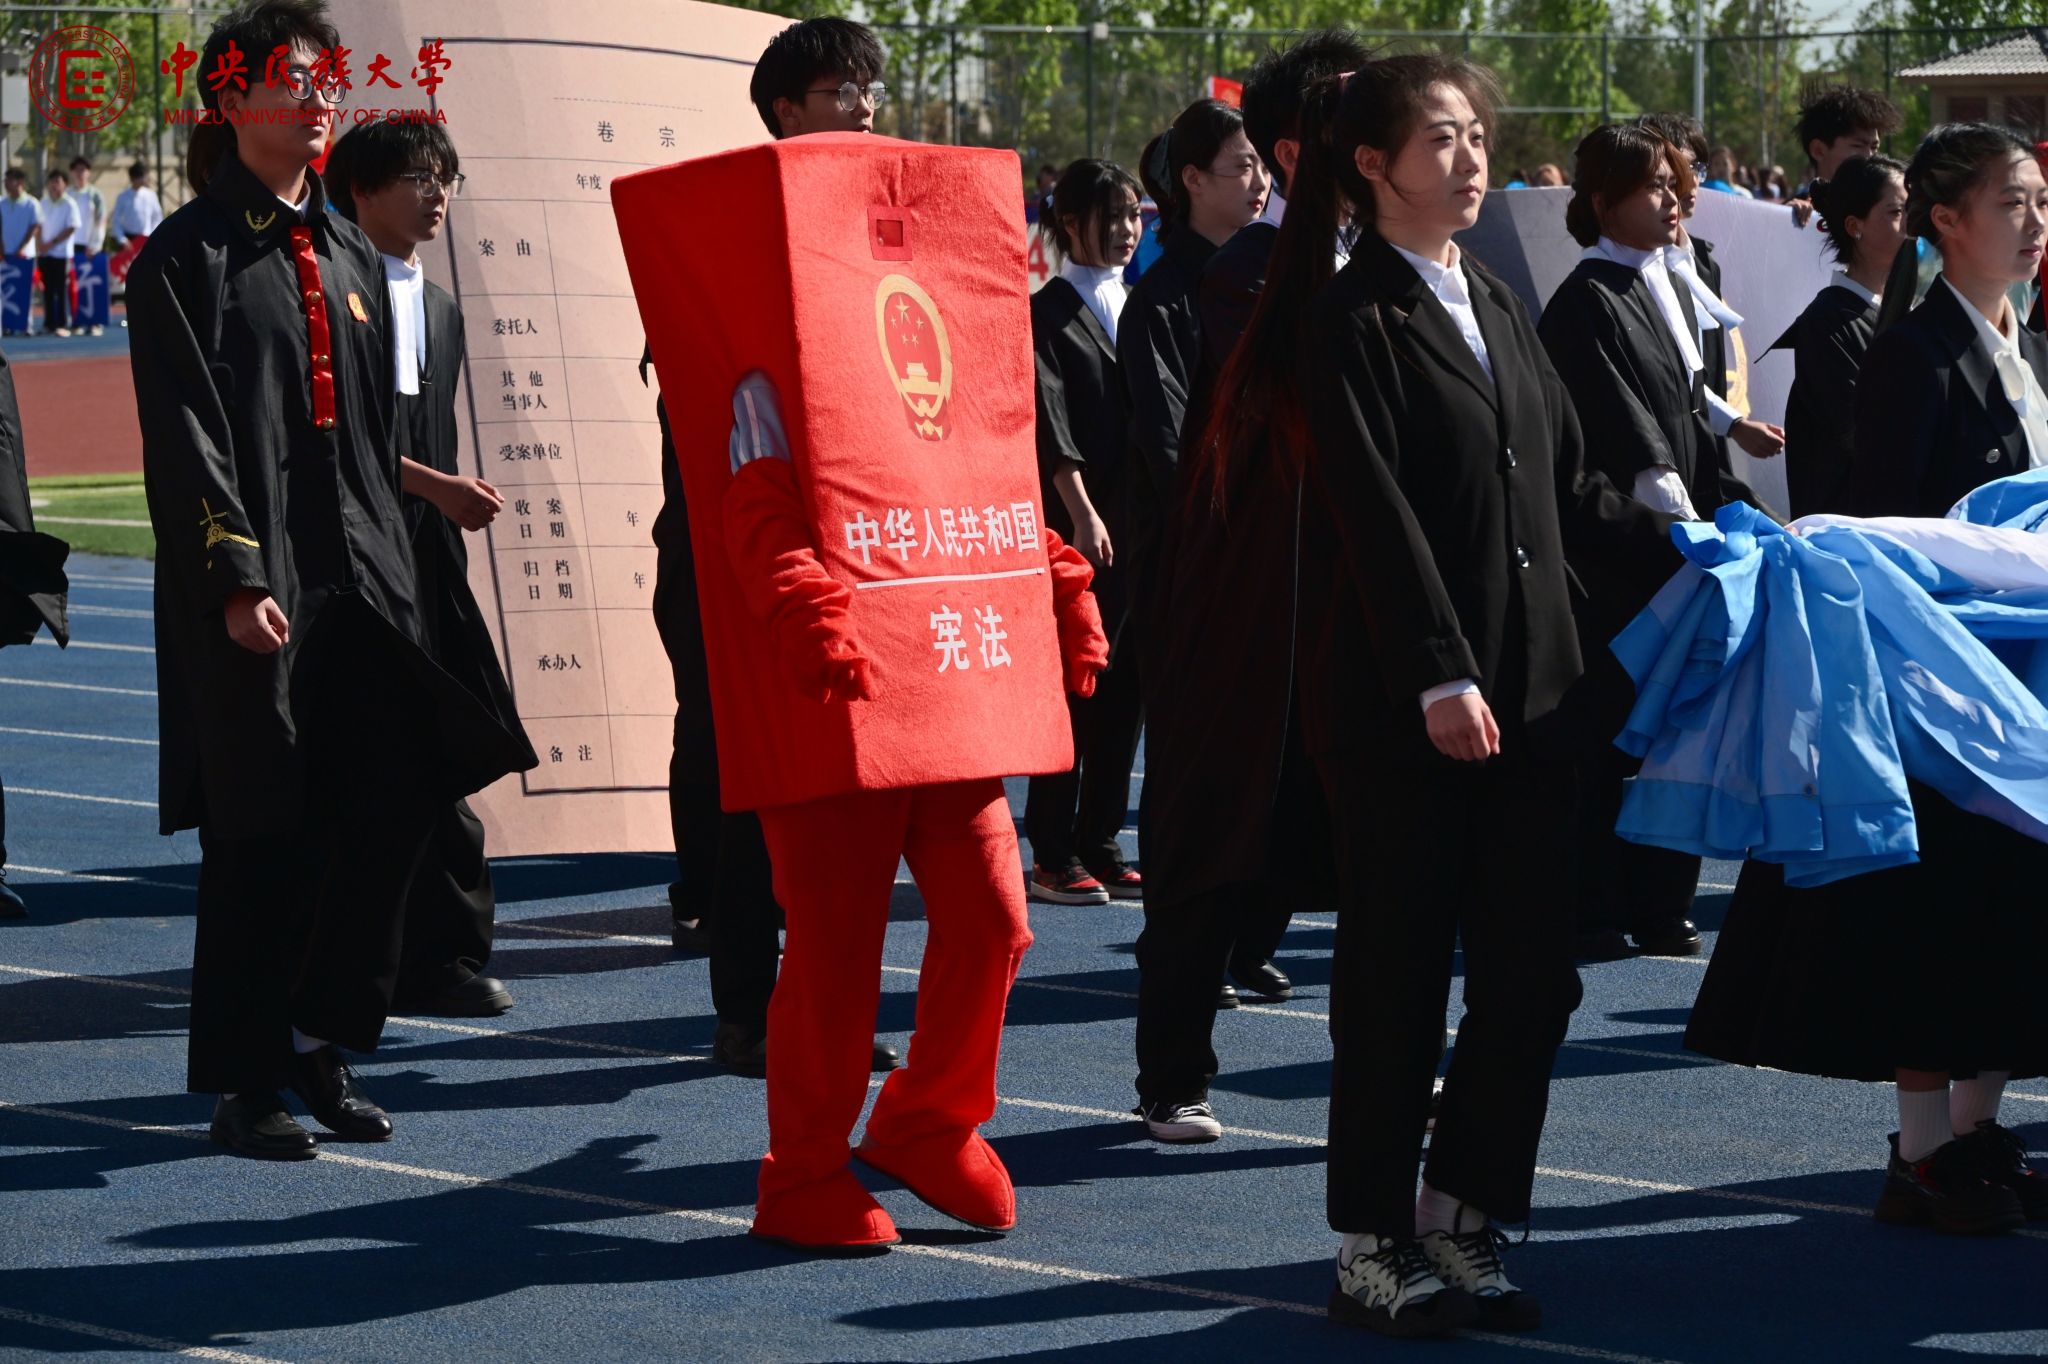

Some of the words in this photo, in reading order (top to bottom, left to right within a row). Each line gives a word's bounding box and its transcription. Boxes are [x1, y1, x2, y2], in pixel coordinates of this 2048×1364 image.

[597, 121, 677, 148] 卷宗
[576, 173, 603, 191] 年度
[478, 238, 531, 257] 案由
[491, 318, 538, 336] 委托人
[500, 370, 544, 388] 其他
[502, 393, 548, 411] 当事人
[499, 443, 562, 462] 受案单位
[515, 498, 562, 516] 收案
[627, 510, 640, 528] 年
[520, 522, 566, 539] 日期
[844, 501, 1040, 565] 中华人民共和国
[523, 559, 570, 578] 归档
[634, 571, 646, 589] 年
[528, 583, 574, 600] 日期
[930, 604, 1012, 673] 宪法
[537, 653, 582, 672] 承办人
[549, 744, 593, 764] 备注
